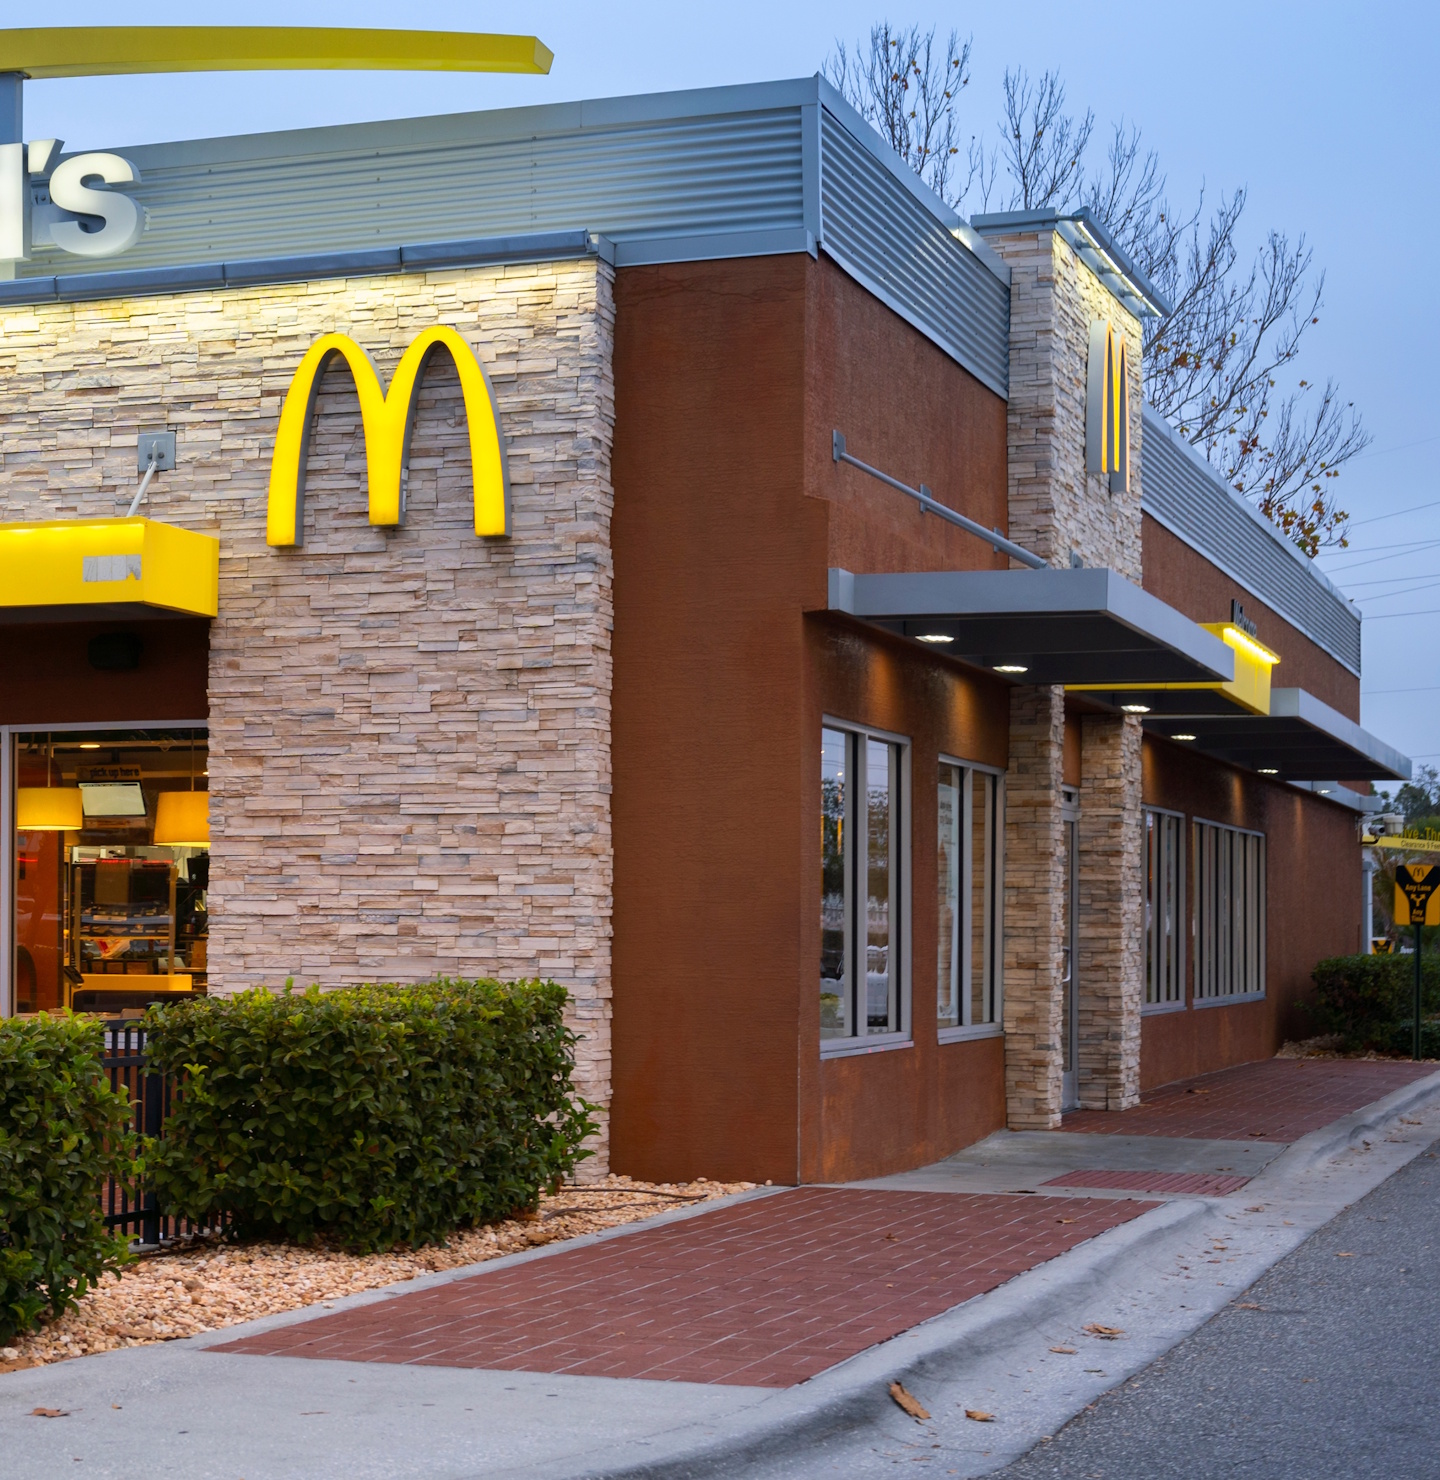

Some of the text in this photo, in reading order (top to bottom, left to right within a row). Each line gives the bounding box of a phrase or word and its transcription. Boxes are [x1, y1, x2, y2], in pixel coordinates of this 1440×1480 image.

[90, 767, 140, 779] pick up here
[1405, 883, 1417, 892] Any
[1411, 909, 1423, 917] Any
